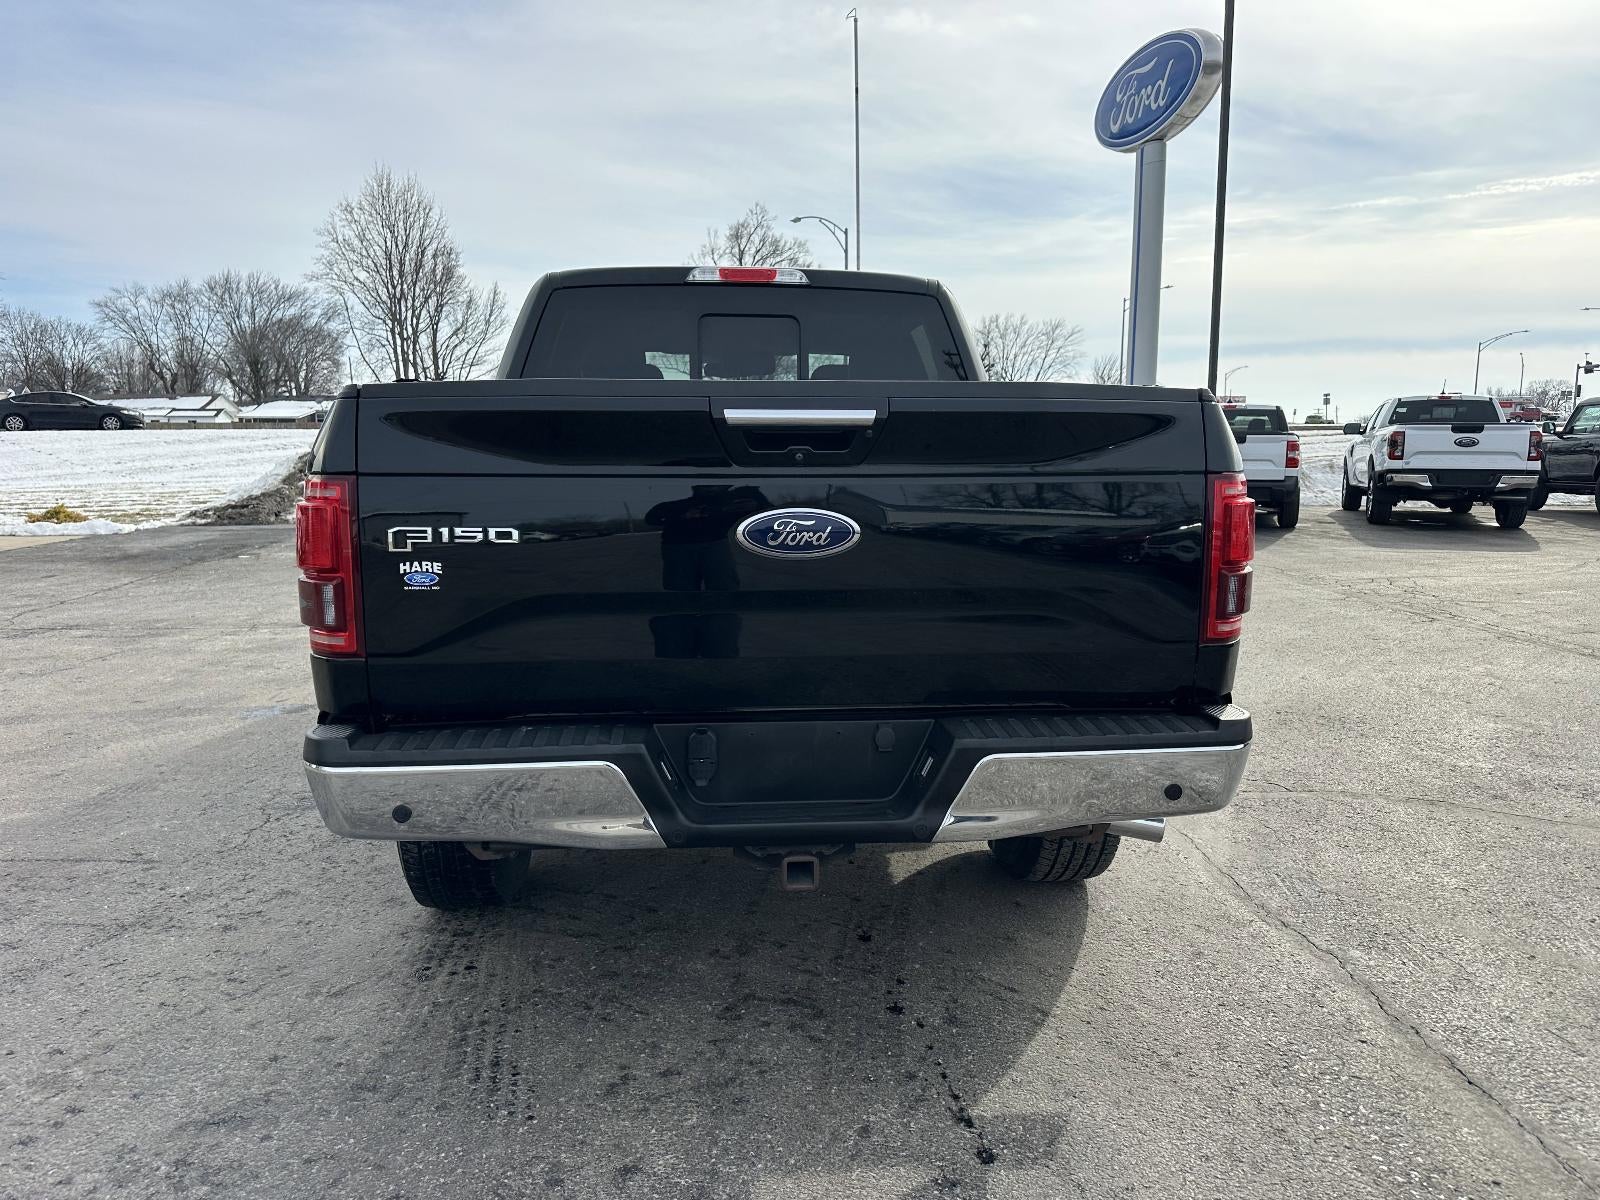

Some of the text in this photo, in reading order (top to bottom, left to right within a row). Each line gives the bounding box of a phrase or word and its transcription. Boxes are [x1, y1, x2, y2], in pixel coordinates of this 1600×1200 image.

[1110, 56, 1174, 133] Ford
[767, 518, 832, 546] Ford
[399, 561, 443, 574] HARE
[411, 574, 432, 583] Ford
